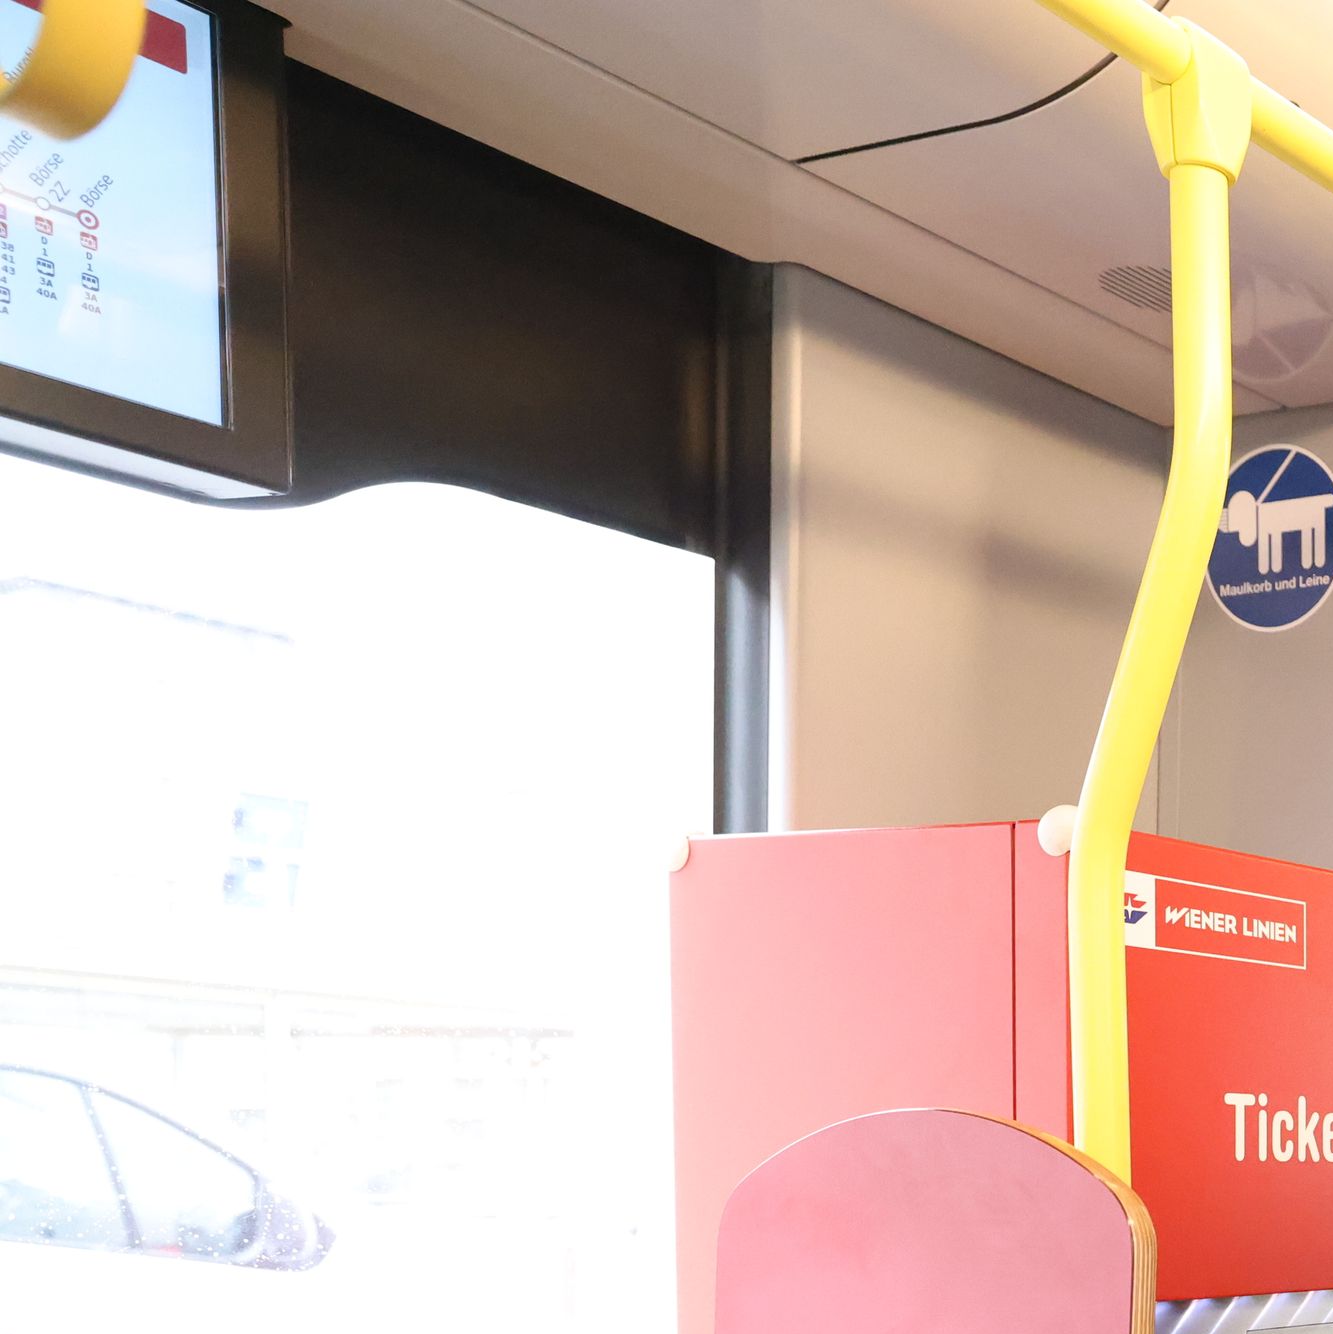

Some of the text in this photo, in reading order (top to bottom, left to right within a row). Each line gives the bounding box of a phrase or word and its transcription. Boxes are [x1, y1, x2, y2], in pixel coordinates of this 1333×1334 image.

[0, 130, 33, 172] chotte
[28, 152, 64, 187] Börse
[80, 174, 114, 208] Börse
[36, 288, 58, 300] 40A
[39, 277, 53, 288] 3A
[81, 302, 102, 315] 40A
[1219, 573, 1330, 597] Maulkorb und Leine
[1165, 905, 1297, 944] WIENER LINIEN
